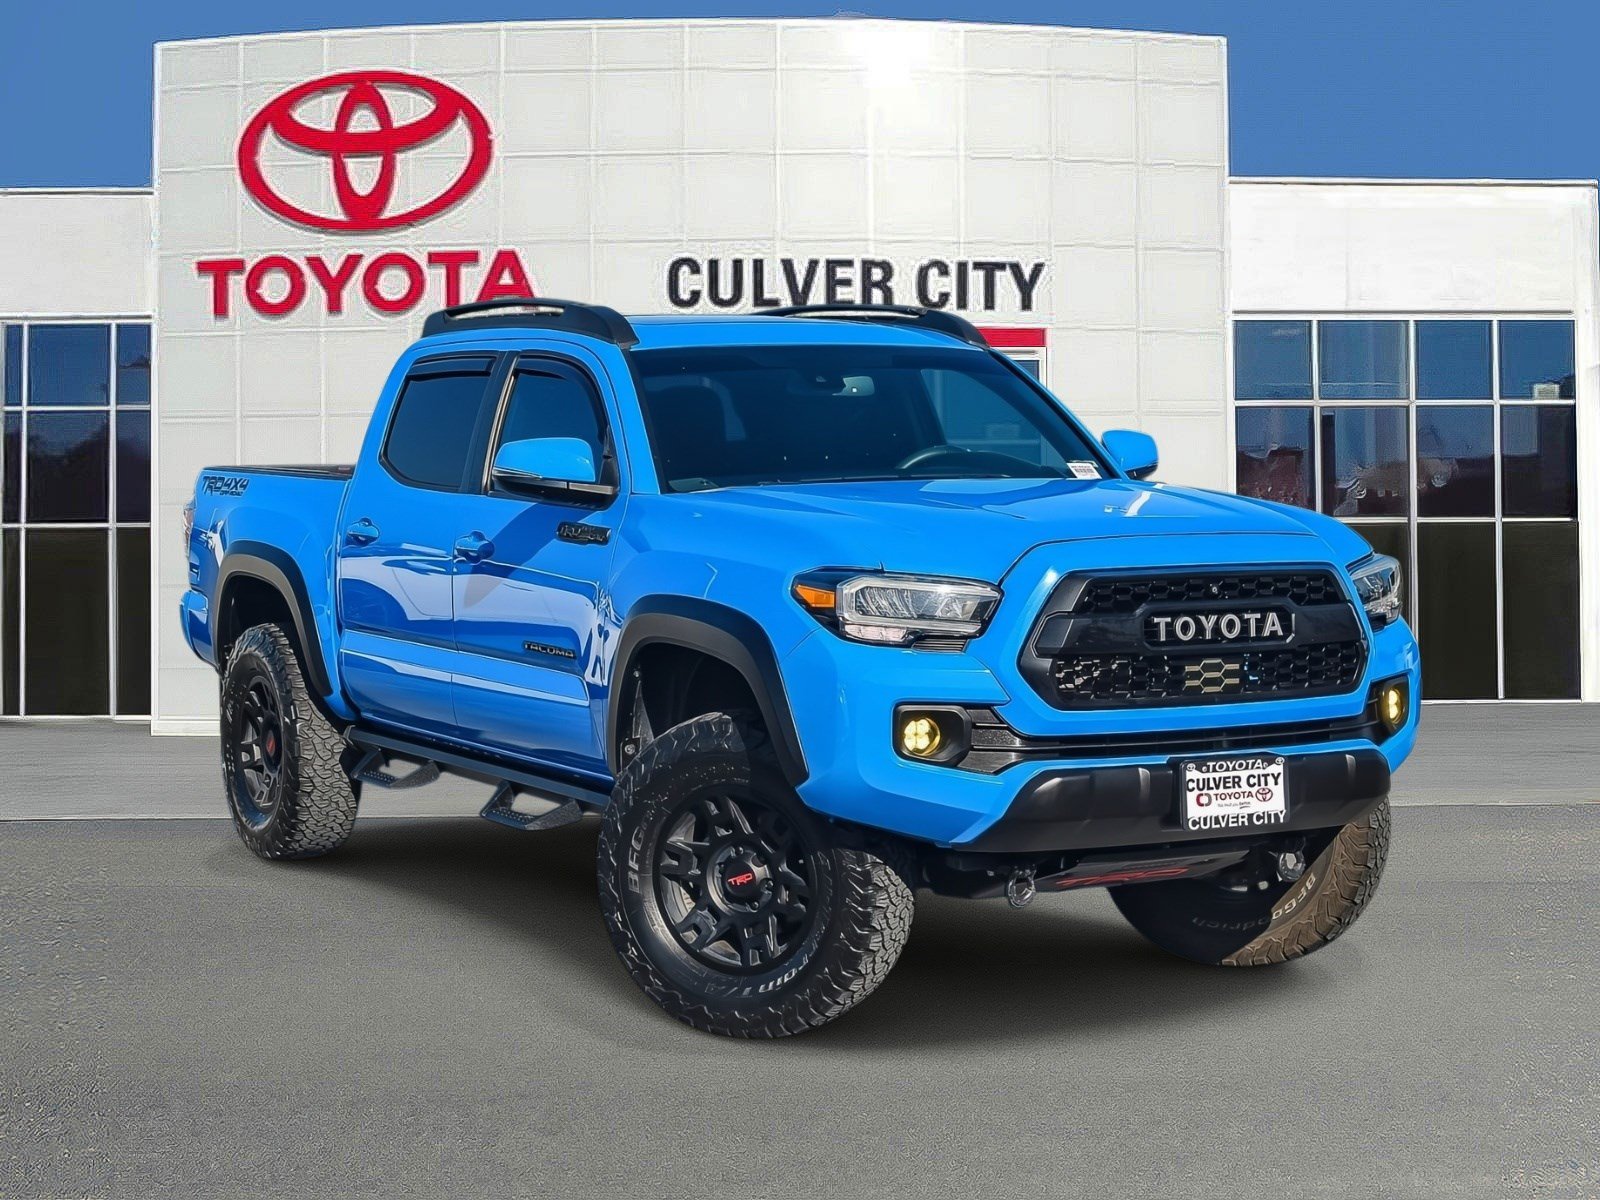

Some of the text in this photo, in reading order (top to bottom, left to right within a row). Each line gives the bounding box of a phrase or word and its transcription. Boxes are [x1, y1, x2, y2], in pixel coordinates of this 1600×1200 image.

[196, 249, 536, 317] TOYOTA
[668, 257, 1046, 311] CULVER CITY
[1153, 612, 1284, 642] TOYOTA
[1206, 759, 1264, 773] TOYOTA
[1186, 772, 1281, 793] CULVER CITY
[1213, 790, 1254, 801] TOYOTA
[1188, 809, 1287, 831] CULVER CITY
[727, 872, 753, 886] TRD
